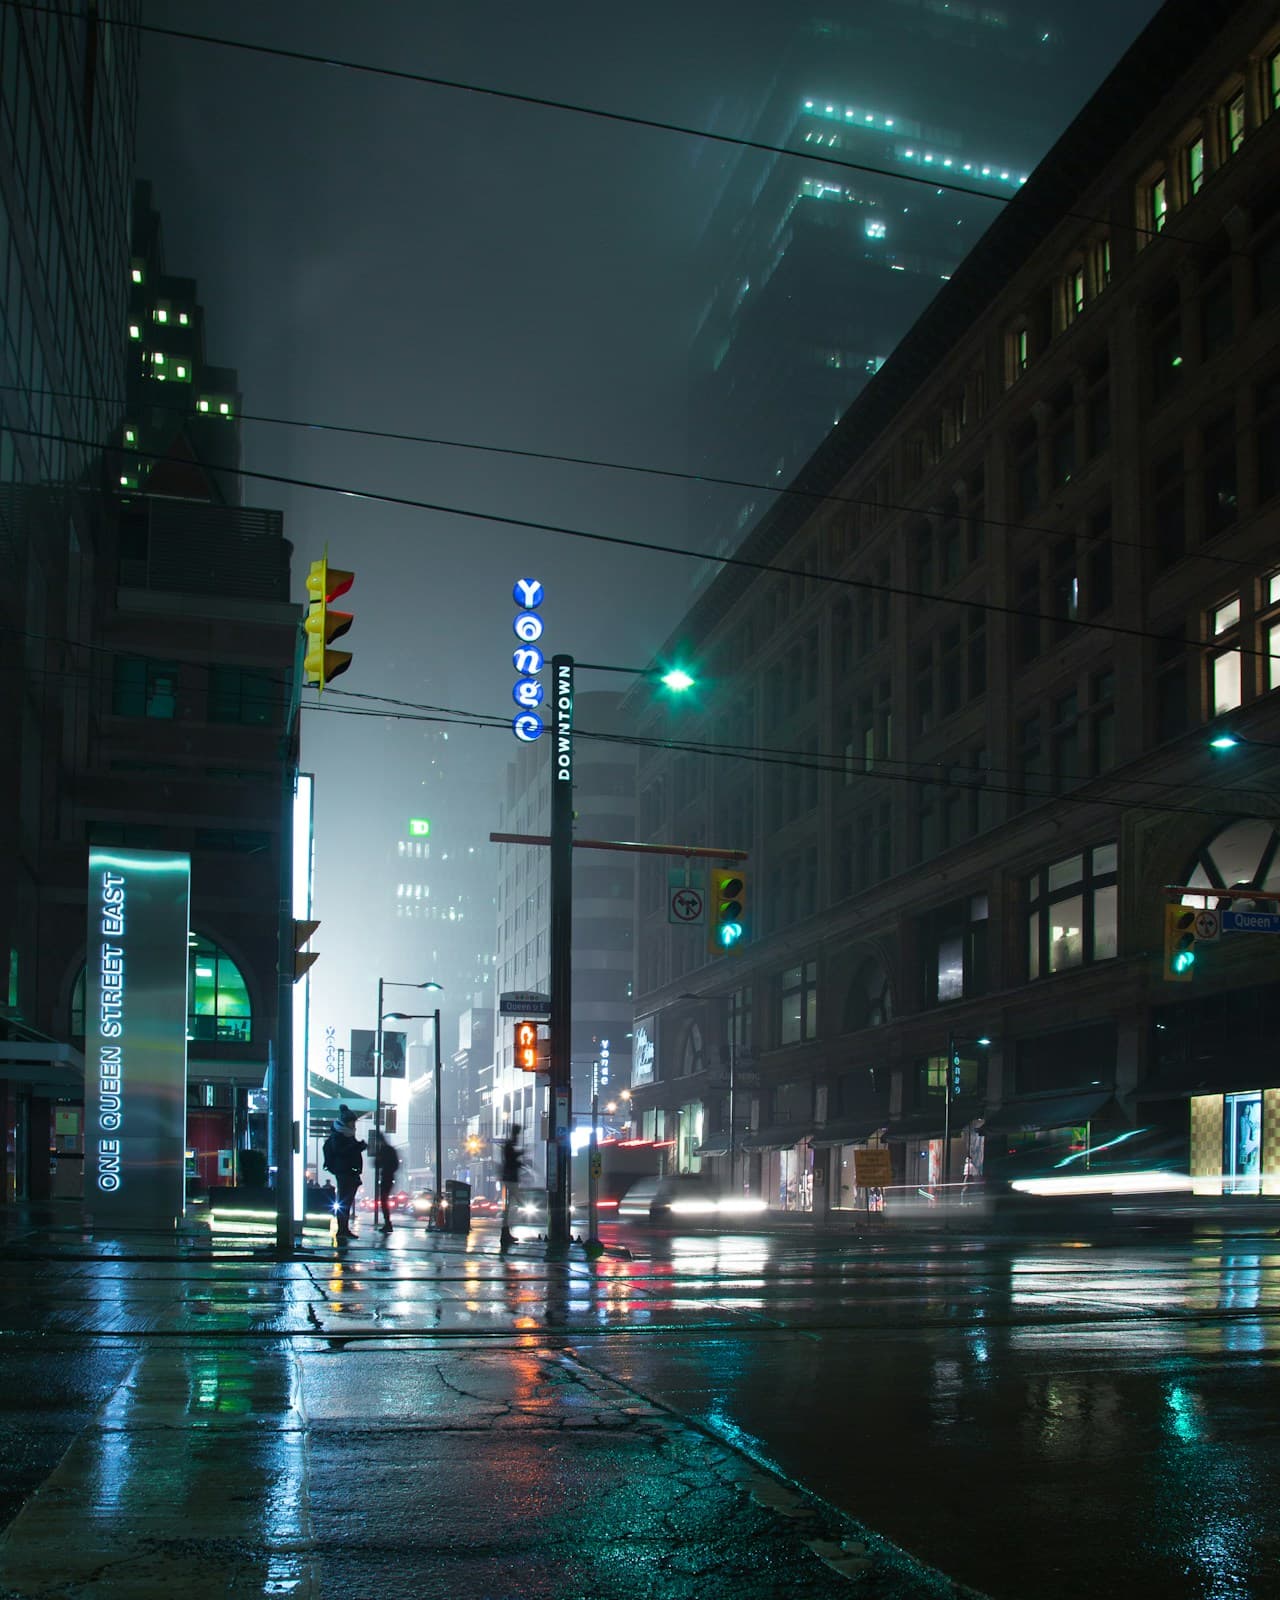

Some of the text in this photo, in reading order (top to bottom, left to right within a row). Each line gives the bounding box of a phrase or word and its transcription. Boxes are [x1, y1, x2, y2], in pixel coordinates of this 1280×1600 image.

[513, 578, 544, 742] Yonge
[557, 665, 571, 782] DOWNTOWN
[410, 819, 429, 834] TD
[1234, 913, 1271, 928] Queen
[98, 872, 125, 1192] ONE QUEEN STREET EAST
[506, 1003, 531, 1012] Queen
